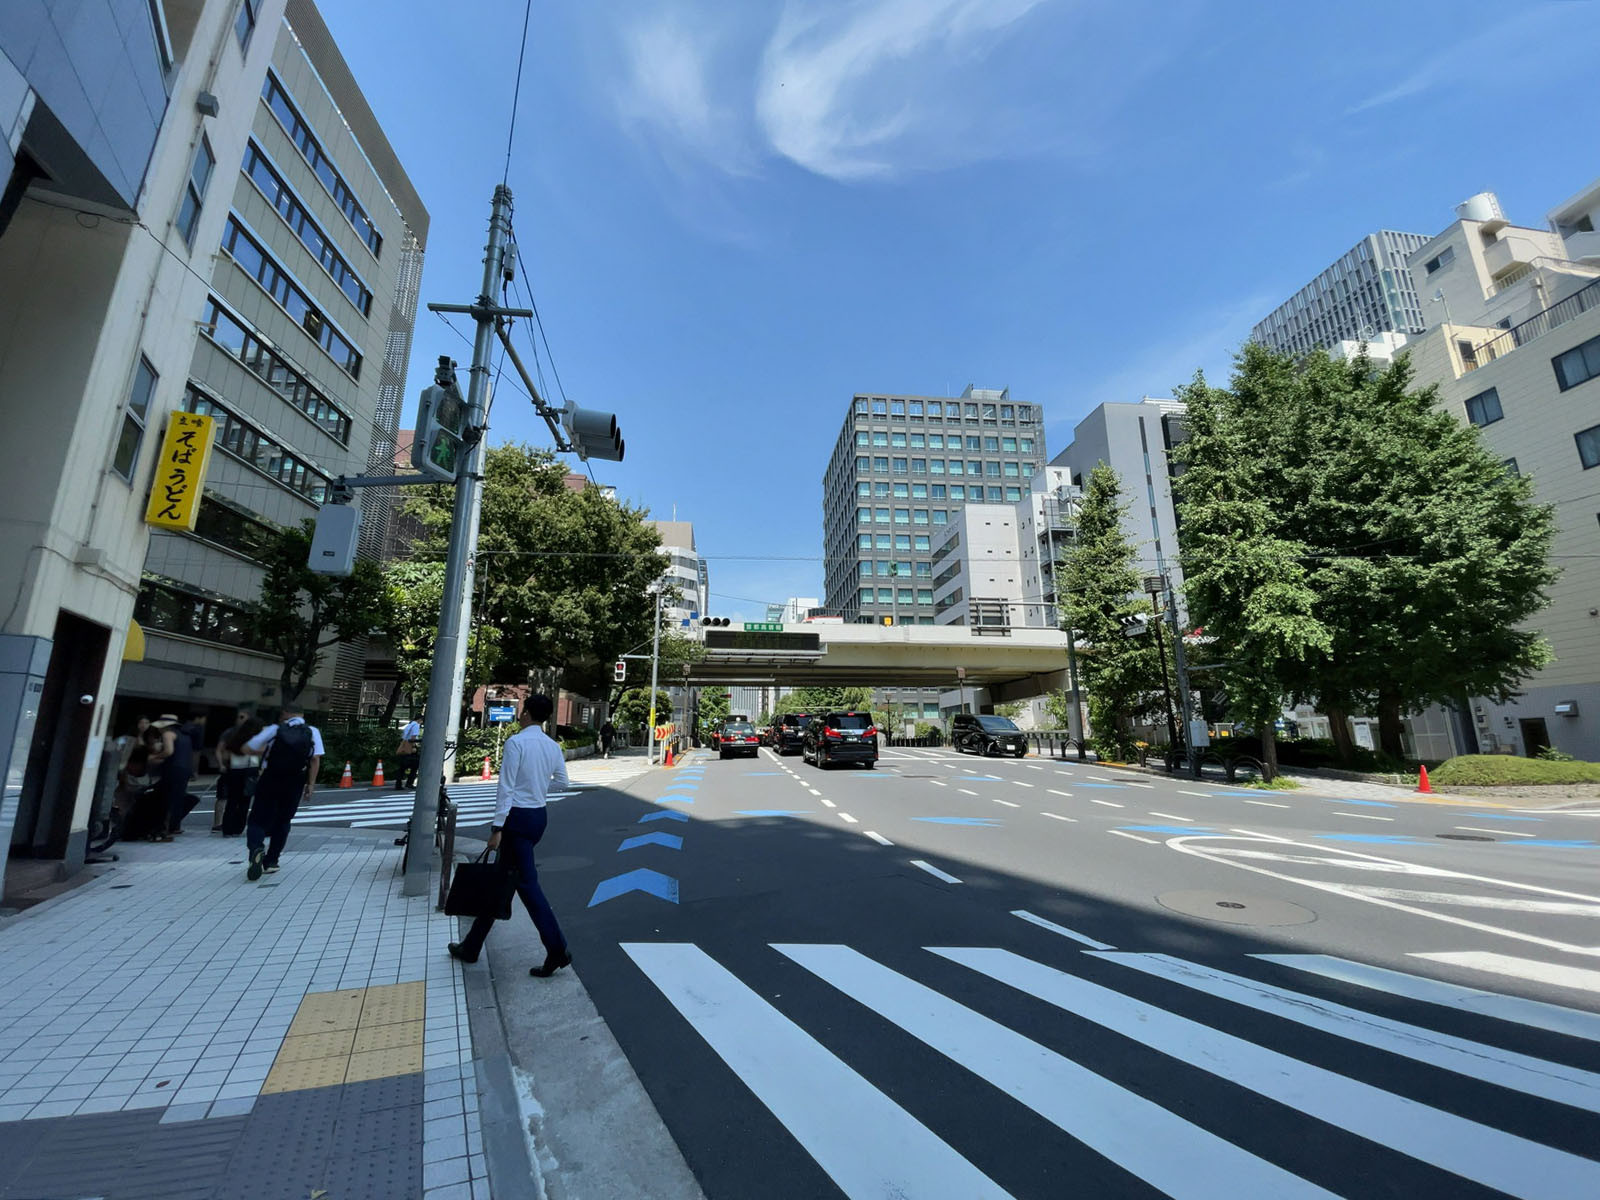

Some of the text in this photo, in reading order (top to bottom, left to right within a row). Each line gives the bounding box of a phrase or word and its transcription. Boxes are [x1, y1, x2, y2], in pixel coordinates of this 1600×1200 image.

[157, 431, 197, 520] そばうどん
